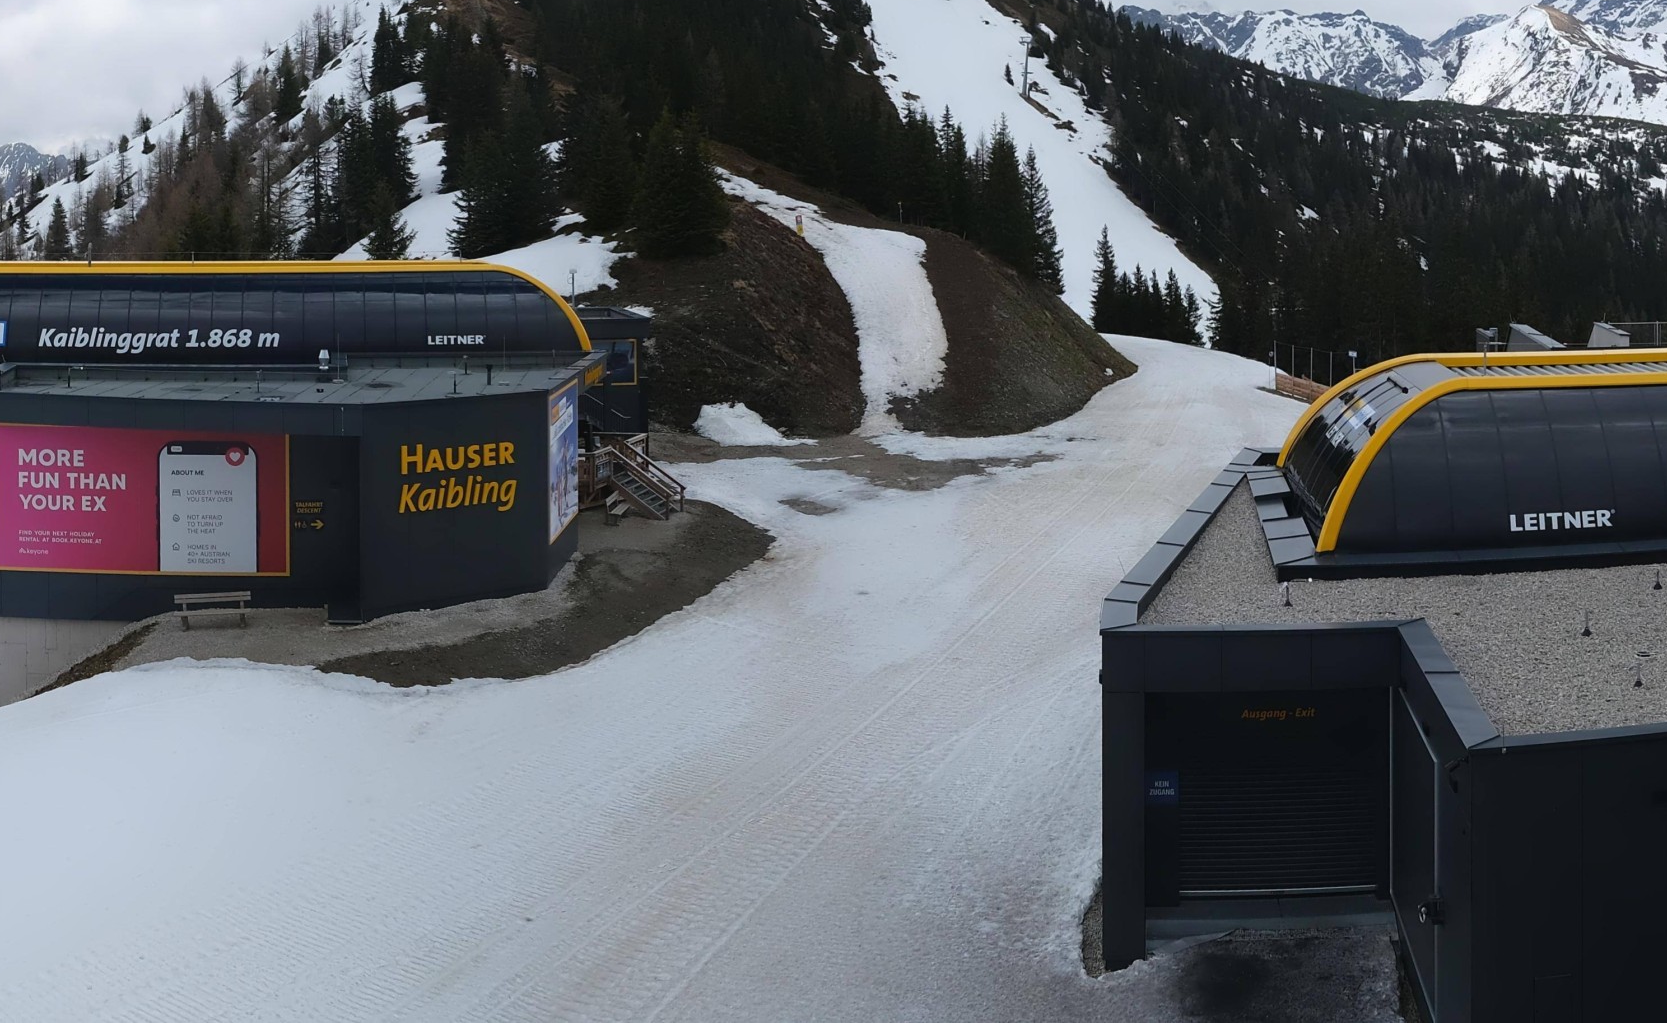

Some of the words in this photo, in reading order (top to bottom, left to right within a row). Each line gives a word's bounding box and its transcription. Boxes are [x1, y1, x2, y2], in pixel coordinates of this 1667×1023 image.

[38, 327, 180, 354] Kaiblinggrat
[185, 328, 252, 348] 1.868
[257, 331, 280, 348] m
[427, 335, 485, 345] LEITNER
[18, 448, 84, 467] MORE
[400, 441, 515, 475] HAUSER
[18, 471, 59, 488] FUN
[66, 472, 126, 490] THAN
[19, 494, 75, 511] YOUR
[81, 495, 107, 512] EX
[398, 475, 517, 514] Kaibling
[1509, 509, 1613, 532] LEITNER
[1241, 708, 1287, 721] Ausgang
[1295, 707, 1316, 717] Exit
